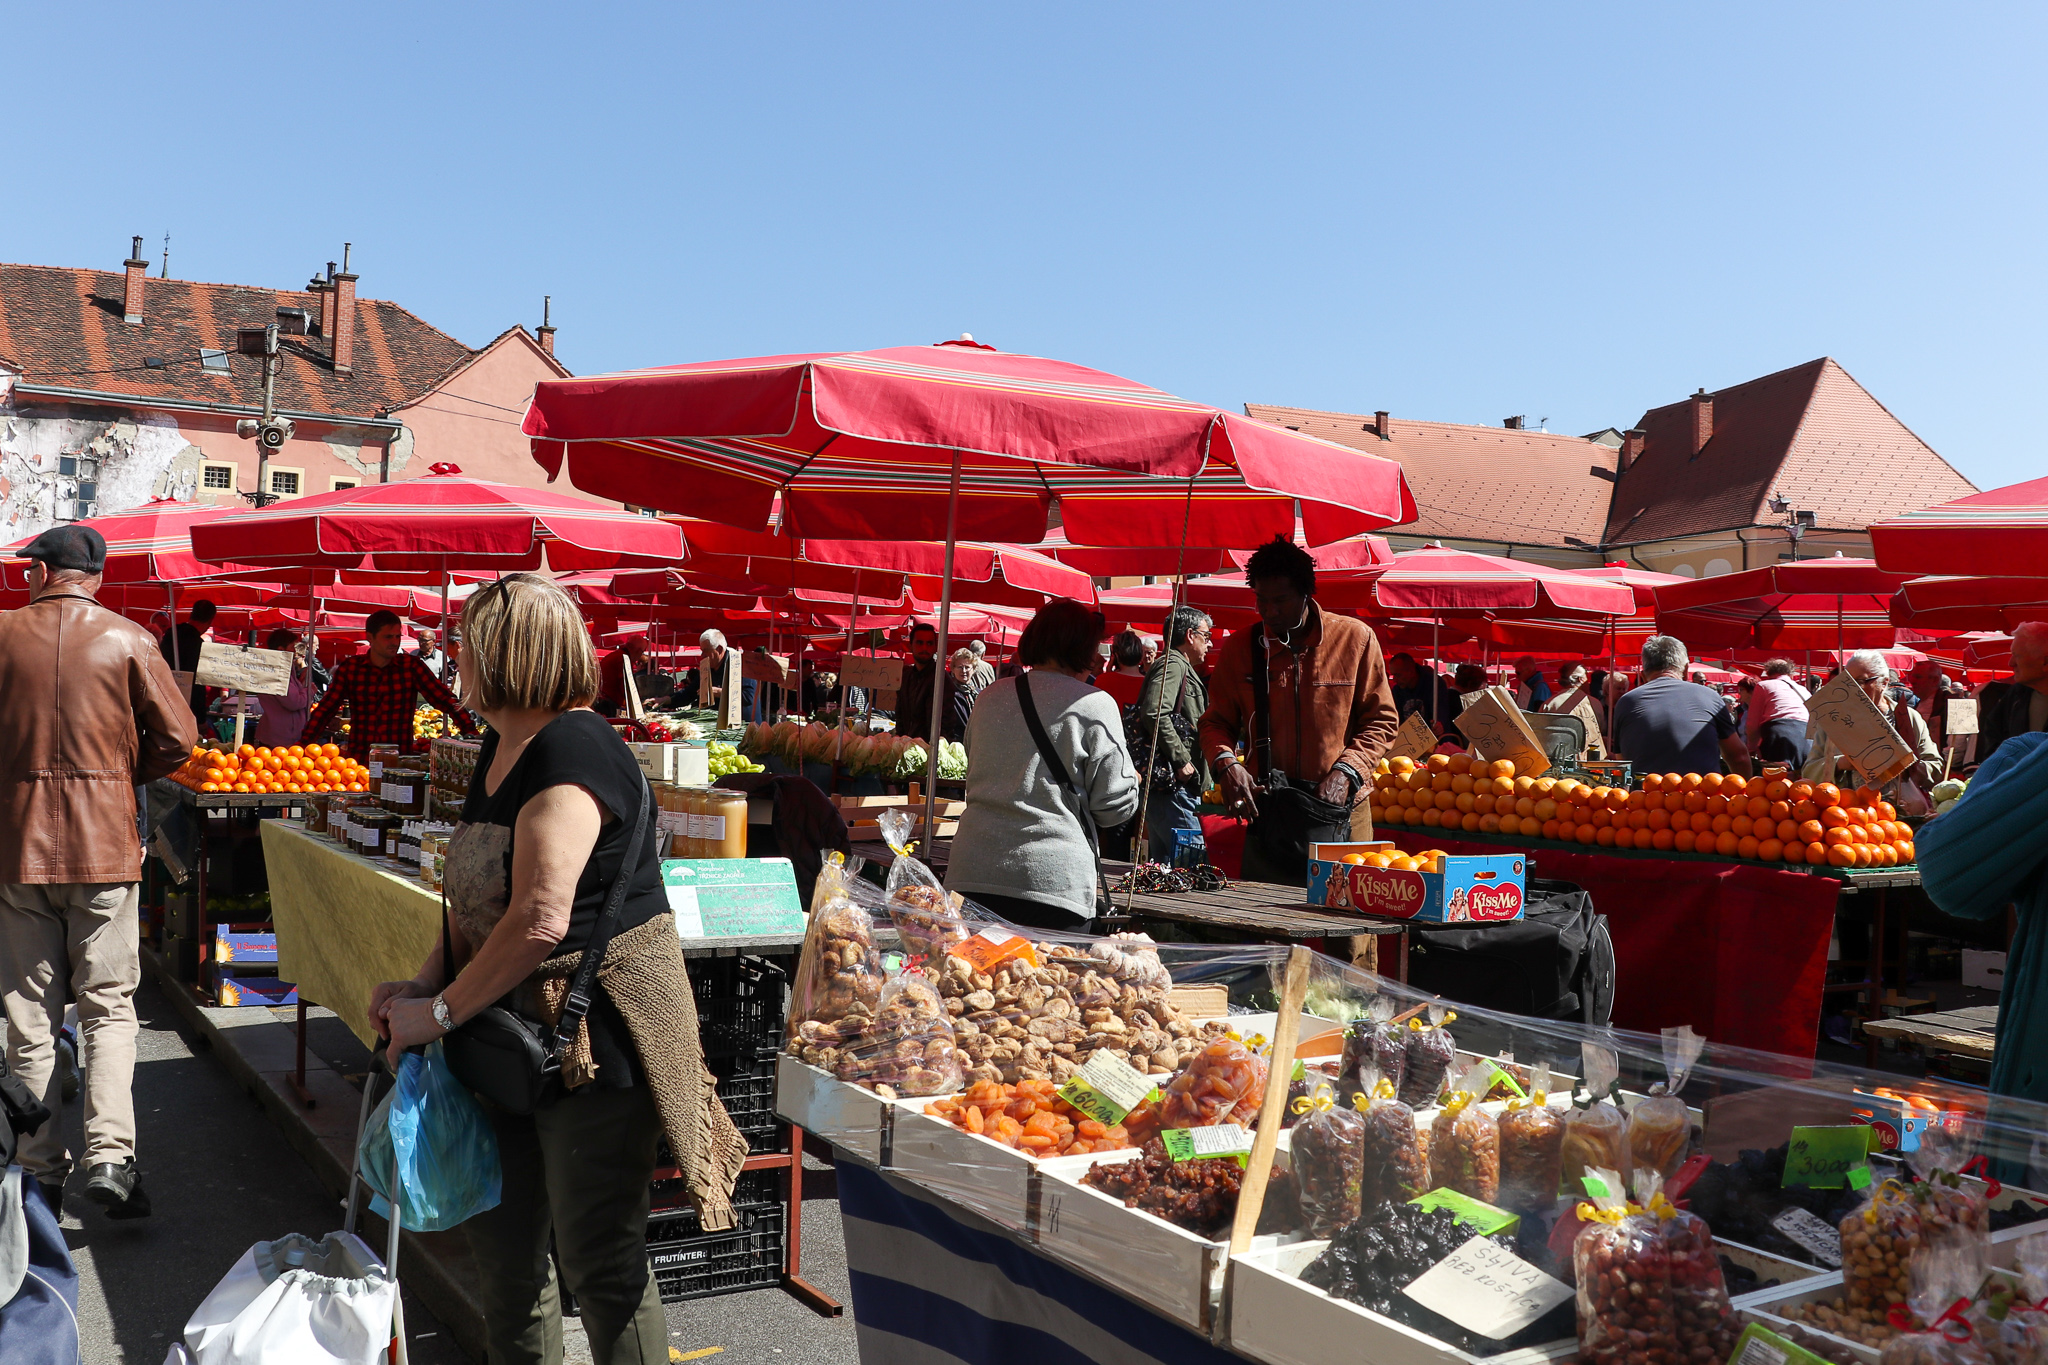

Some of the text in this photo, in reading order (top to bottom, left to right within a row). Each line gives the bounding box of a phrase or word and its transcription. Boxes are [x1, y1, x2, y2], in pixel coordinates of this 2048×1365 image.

[606, 869, 630, 918] LACOSTE
[1355, 873, 1419, 907] KissMe
[1385, 903, 1407, 912] sweet!
[1472, 891, 1519, 917] KissMe
[1798, 1157, 1850, 1177] 30,00
[1443, 1255, 1476, 1276] BEZ
